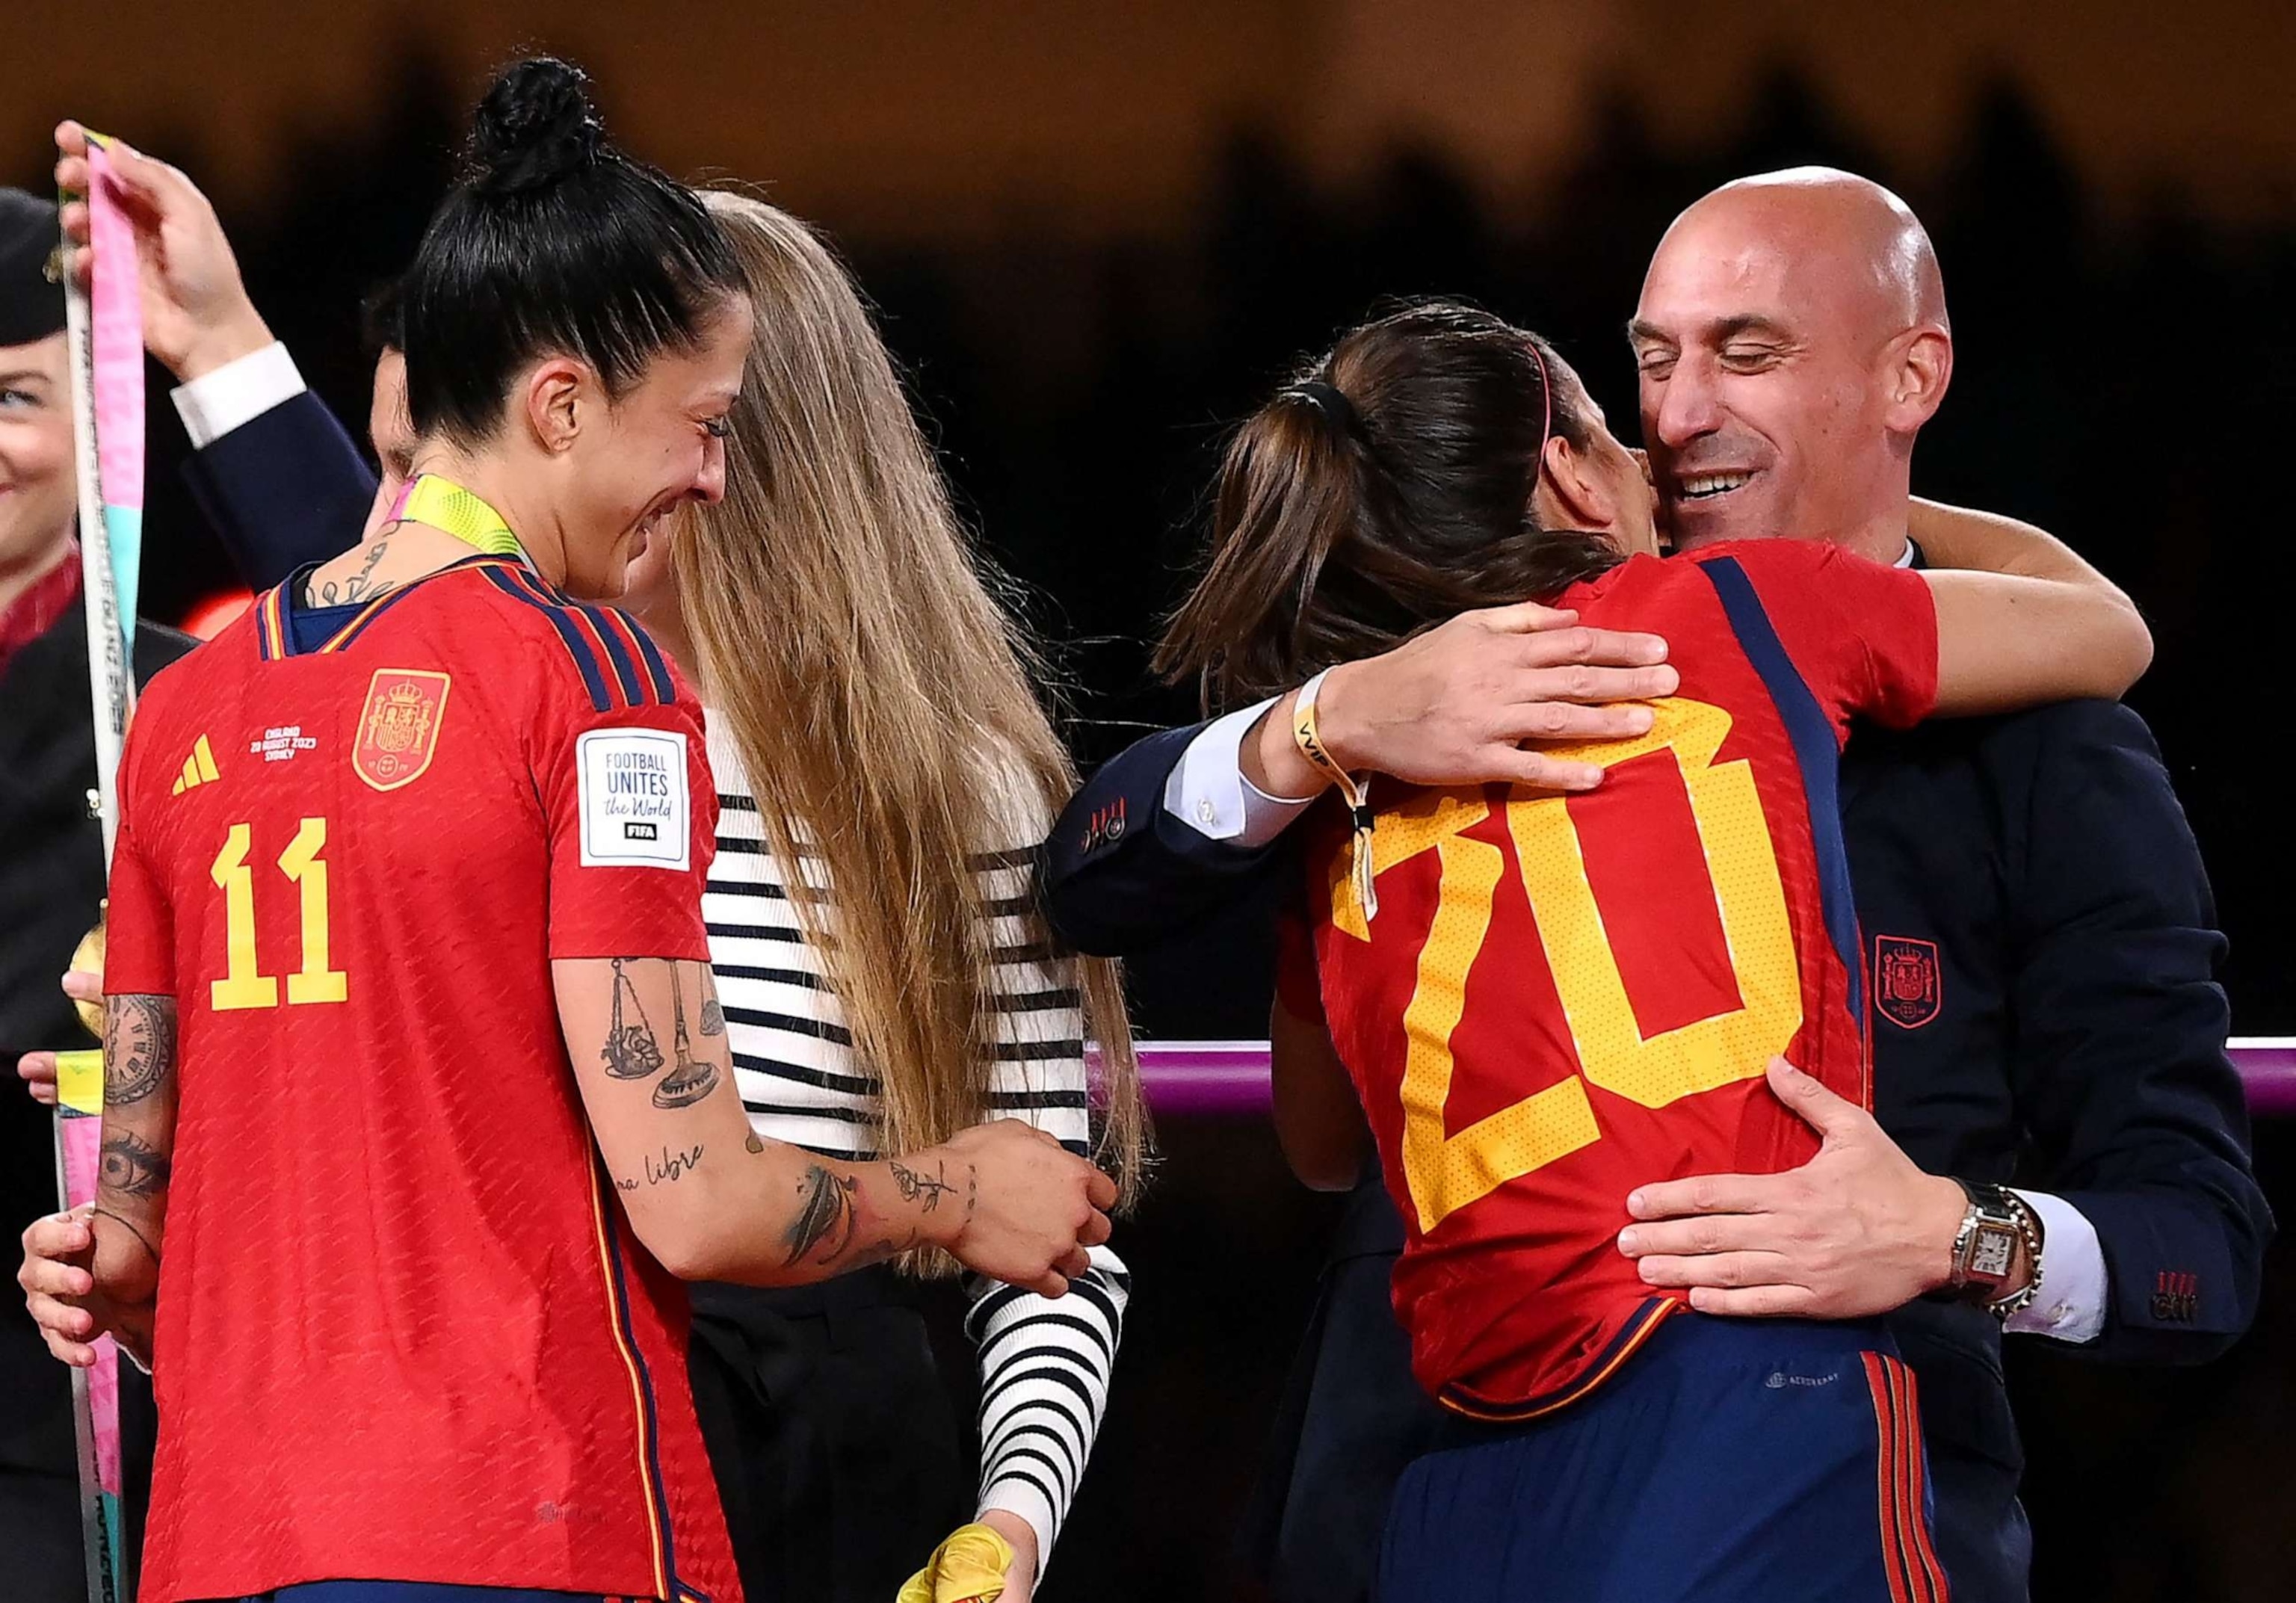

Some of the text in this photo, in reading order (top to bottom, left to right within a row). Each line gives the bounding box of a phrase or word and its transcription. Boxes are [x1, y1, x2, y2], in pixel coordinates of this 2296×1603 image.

[1300, 722, 1330, 767] VVIP
[605, 753, 667, 772] FOOTBALL
[607, 771, 668, 797] UNITES
[604, 797, 673, 822] the World
[626, 824, 655, 838] FIFA
[210, 818, 348, 1011] 11
[1329, 697, 1803, 1235] 20
[644, 1144, 704, 1185] libre
